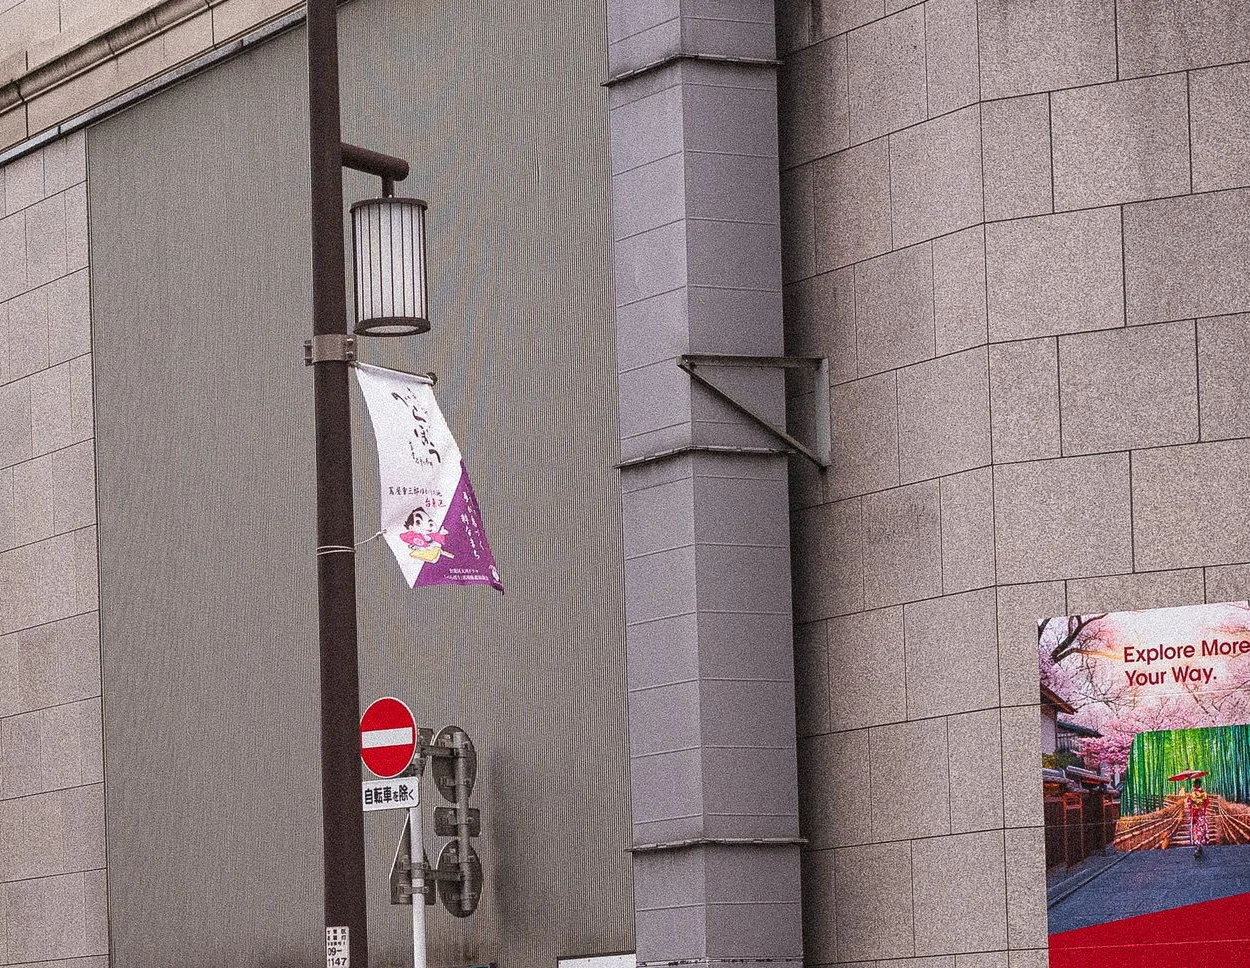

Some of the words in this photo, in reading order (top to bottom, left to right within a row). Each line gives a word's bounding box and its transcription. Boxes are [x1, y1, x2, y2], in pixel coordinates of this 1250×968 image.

[1123, 643, 1196, 665] Explore
[1201, 639, 1250, 657] More
[1125, 669, 1167, 687] Your
[1171, 665, 1217, 685] Way.
[364, 784, 414, 805] 自転車を除く
[327, 957, 347, 967] 1147
